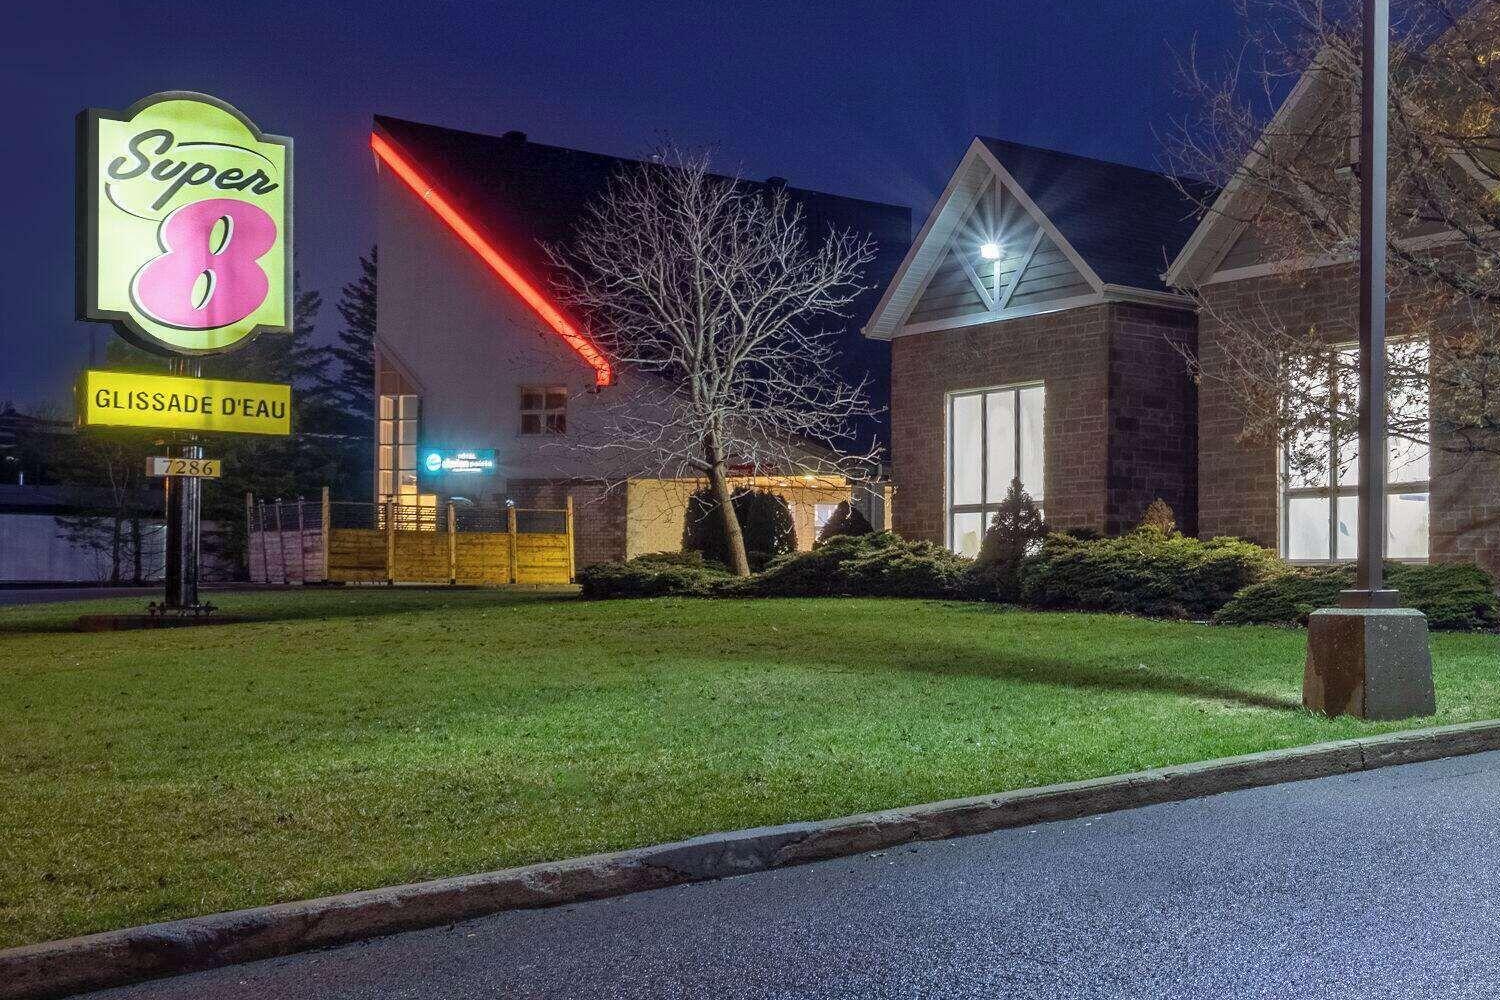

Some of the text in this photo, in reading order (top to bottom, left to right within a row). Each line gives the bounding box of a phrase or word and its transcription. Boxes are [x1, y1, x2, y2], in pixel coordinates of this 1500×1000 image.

[107, 128, 279, 211] Super
[128, 198, 278, 331] 8
[95, 388, 286, 420] GLISSADE D'EAU
[162, 460, 213, 476] 7286
